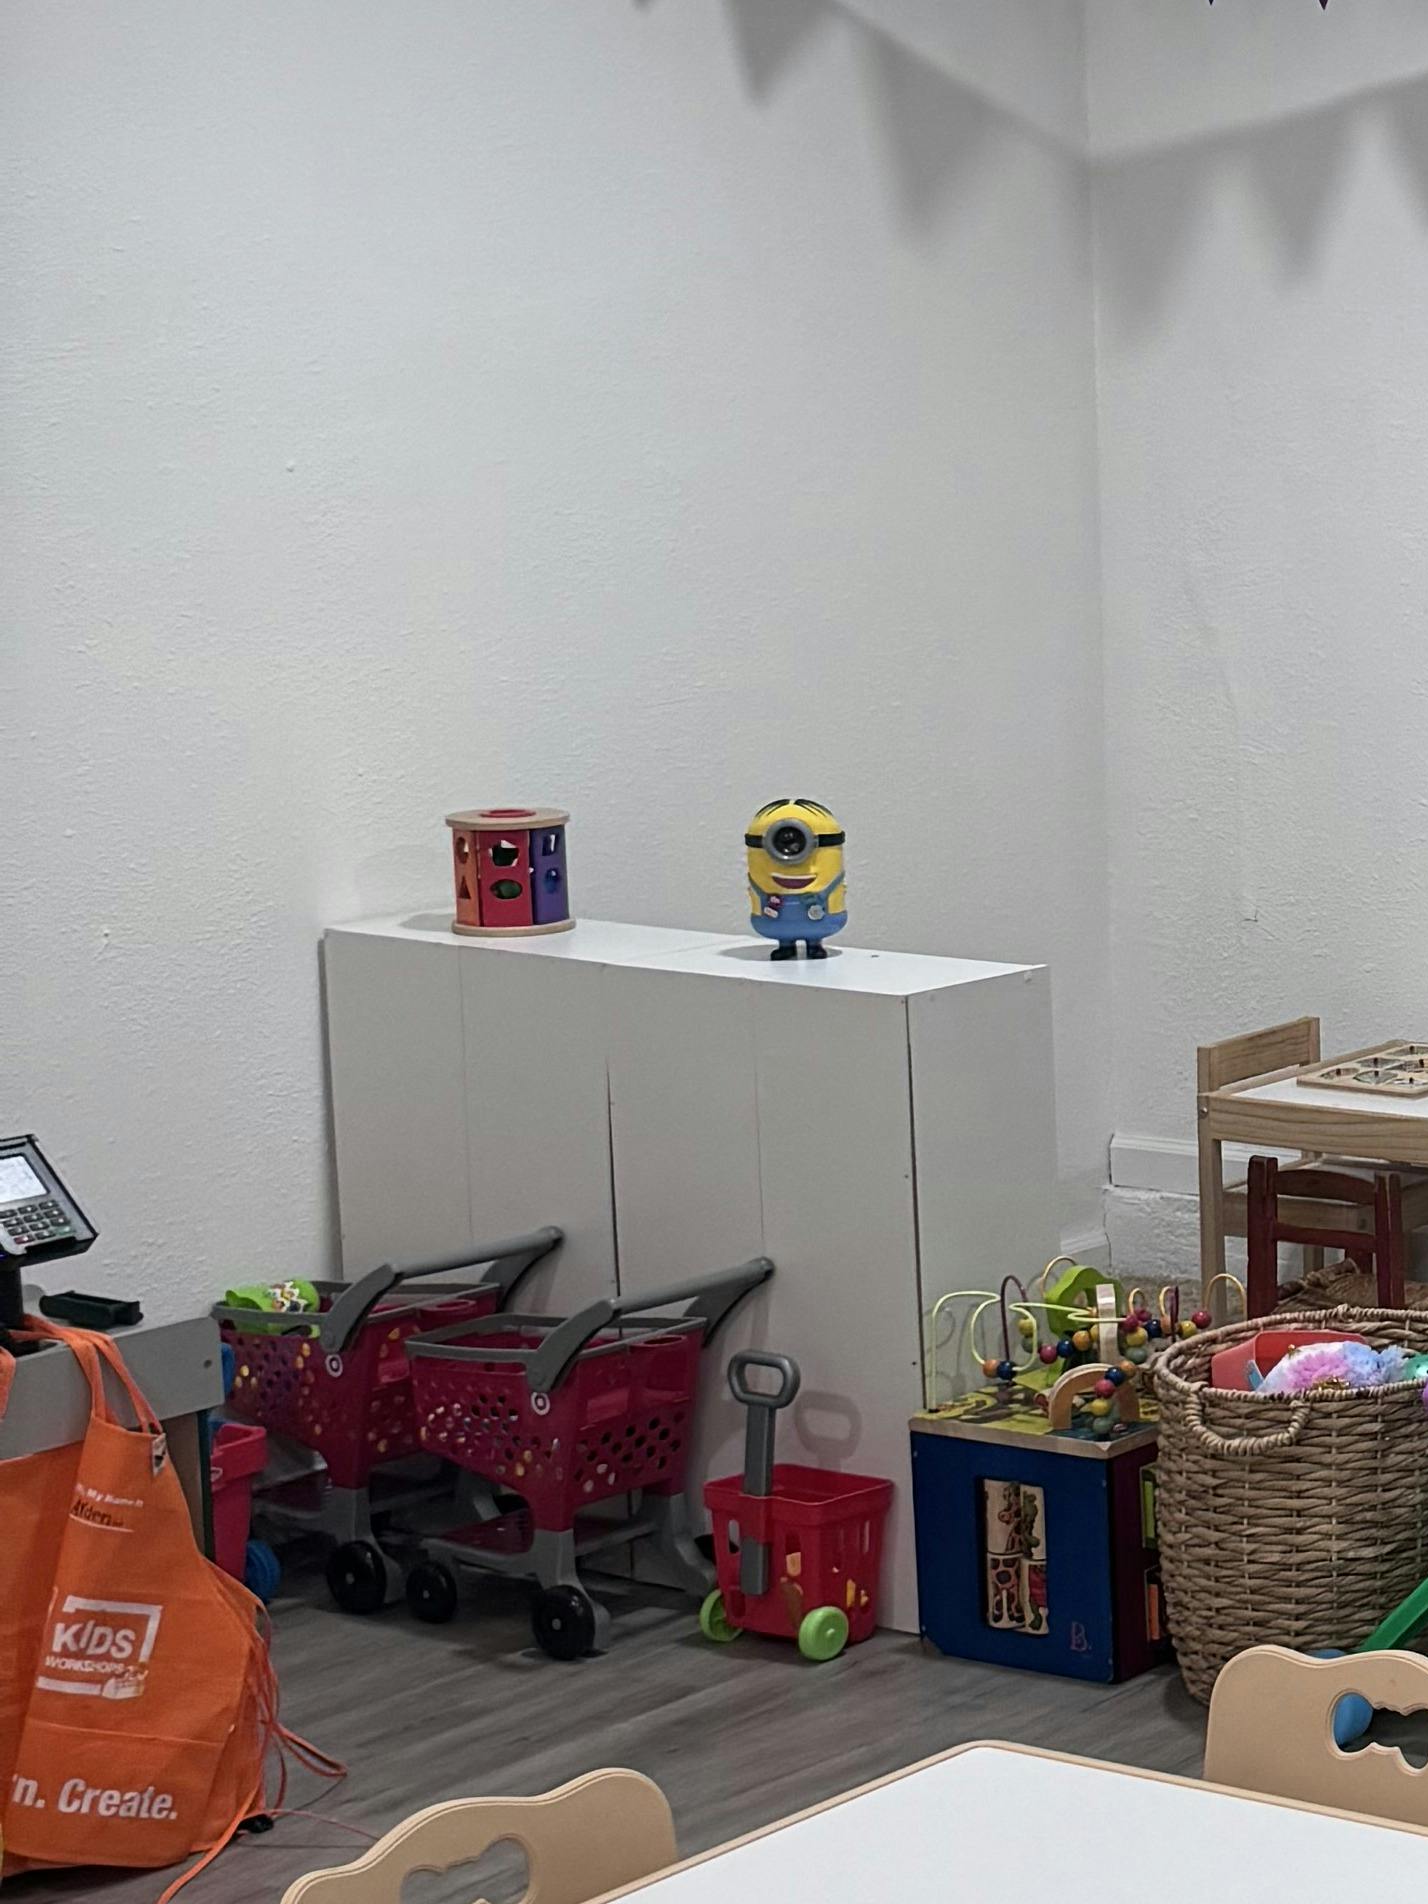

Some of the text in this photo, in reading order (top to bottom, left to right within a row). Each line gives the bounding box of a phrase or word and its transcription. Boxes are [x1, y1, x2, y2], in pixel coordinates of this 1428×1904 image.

[52, 1619, 136, 1660] KIDS
[44, 1654, 125, 1675] WORKSHOPS
[57, 1778, 179, 1821] Create.
